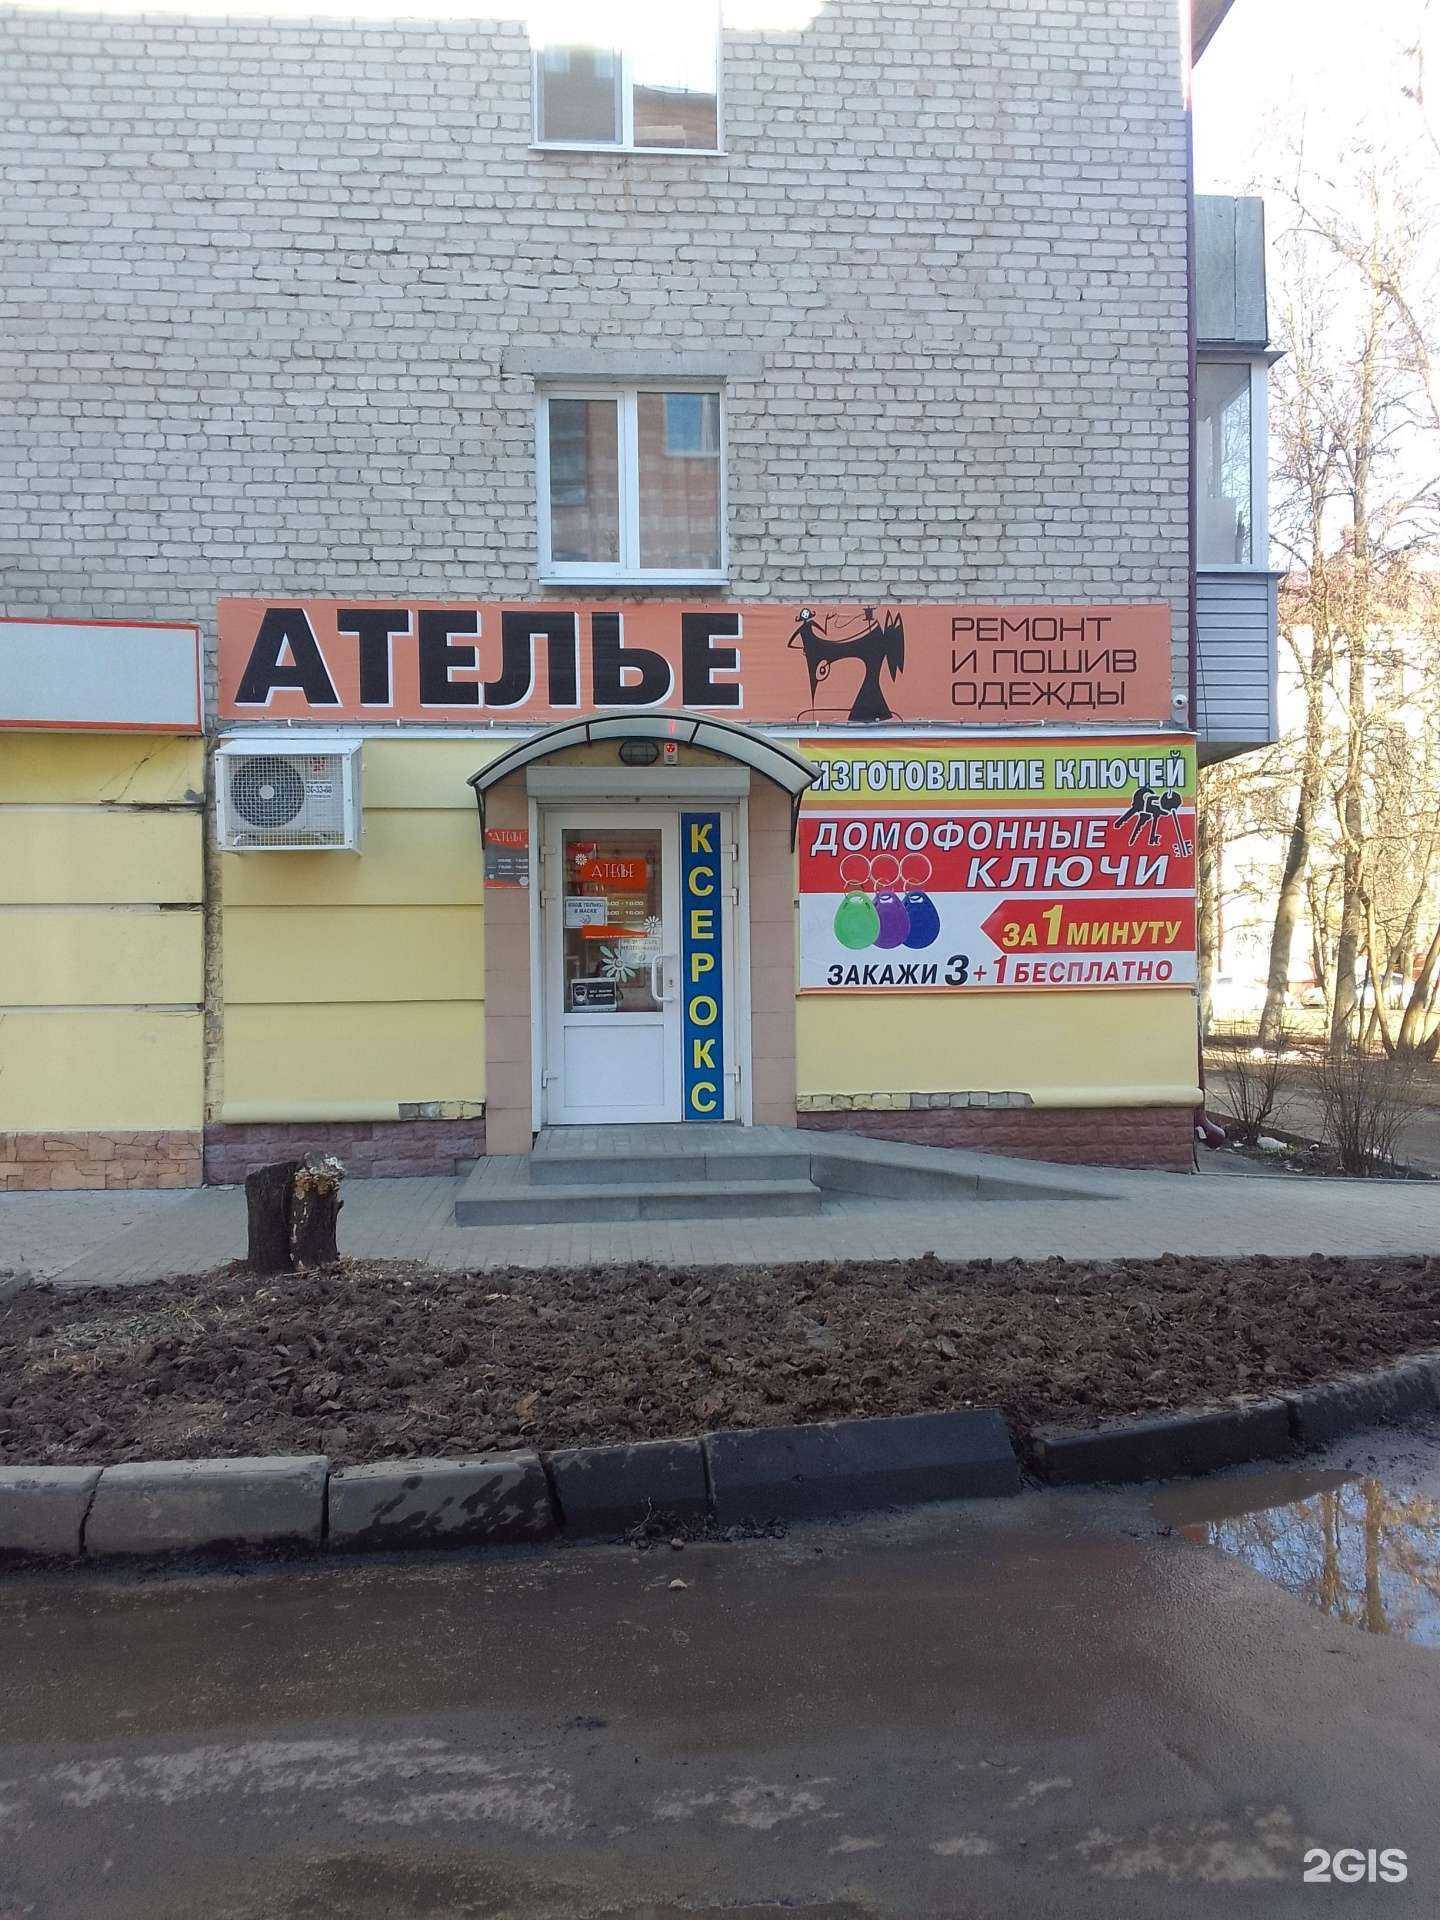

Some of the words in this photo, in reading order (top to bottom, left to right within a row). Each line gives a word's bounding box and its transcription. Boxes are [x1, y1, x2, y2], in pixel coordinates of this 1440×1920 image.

[951, 617, 1112, 642] РЕМОНТ
[234, 607, 744, 709] АТЕЛЬЕ
[951, 649, 977, 674] И
[992, 649, 1137, 674] ПОШИВ
[951, 681, 1126, 710] ОДЕЖДЫ
[810, 759, 1045, 791] ИЗГОТОВЛЕНИЕ
[1054, 750, 1187, 789] КЛЮЧЕЙ
[810, 820, 1109, 857] ДОМОФОННЫЕ
[966, 855, 1170, 889] КЛЮЧИ
[1002, 923, 1038, 947] ЗА
[1042, 904, 1064, 946] 1
[1066, 920, 1182, 946] МИНУТУ
[688, 823, 718, 1113] КСЕРОКС
[827, 964, 938, 985] ЗАКАЖИ
[1014, 960, 1173, 984] БЕСПЛАТНО
